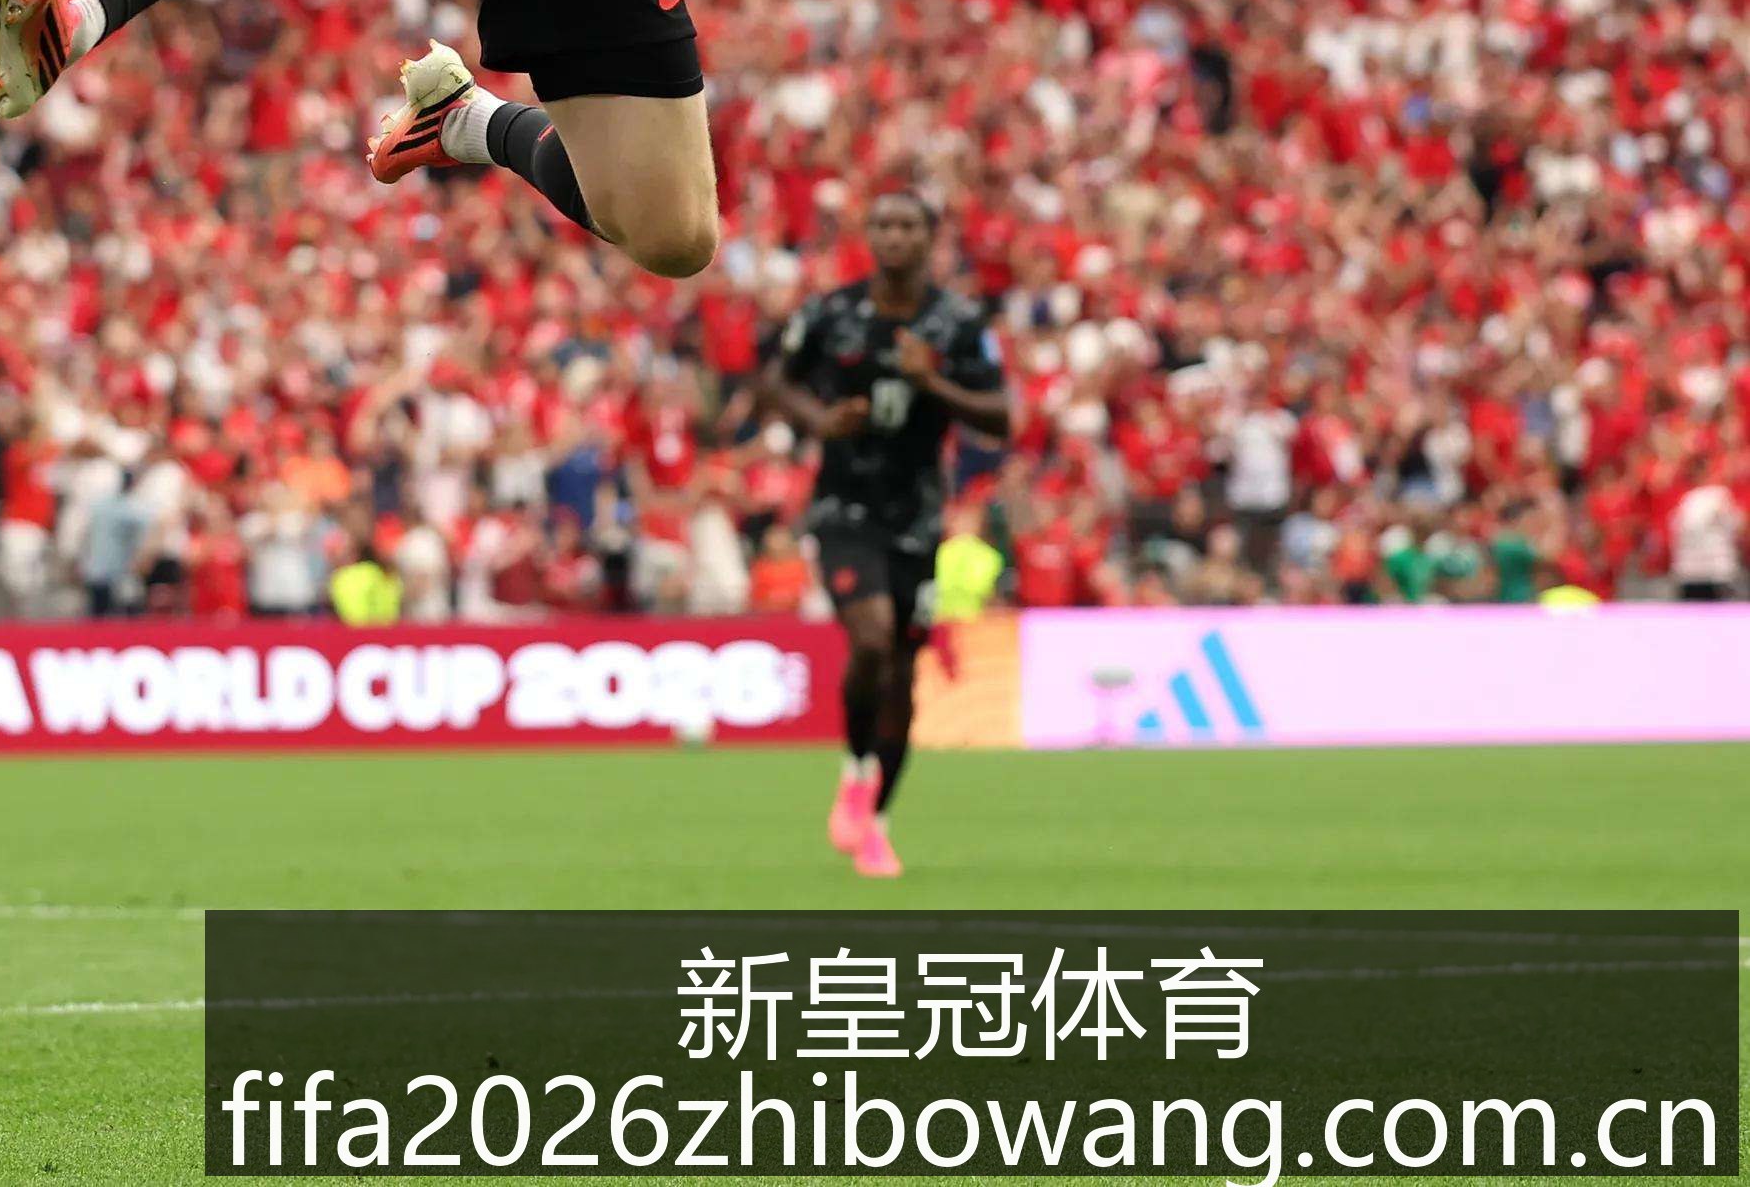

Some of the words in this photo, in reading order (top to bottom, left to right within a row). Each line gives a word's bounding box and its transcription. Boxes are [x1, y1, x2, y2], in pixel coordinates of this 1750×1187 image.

[30, 645, 335, 733] WORLD
[337, 643, 506, 732] CUP
[506, 640, 784, 729] 2026
